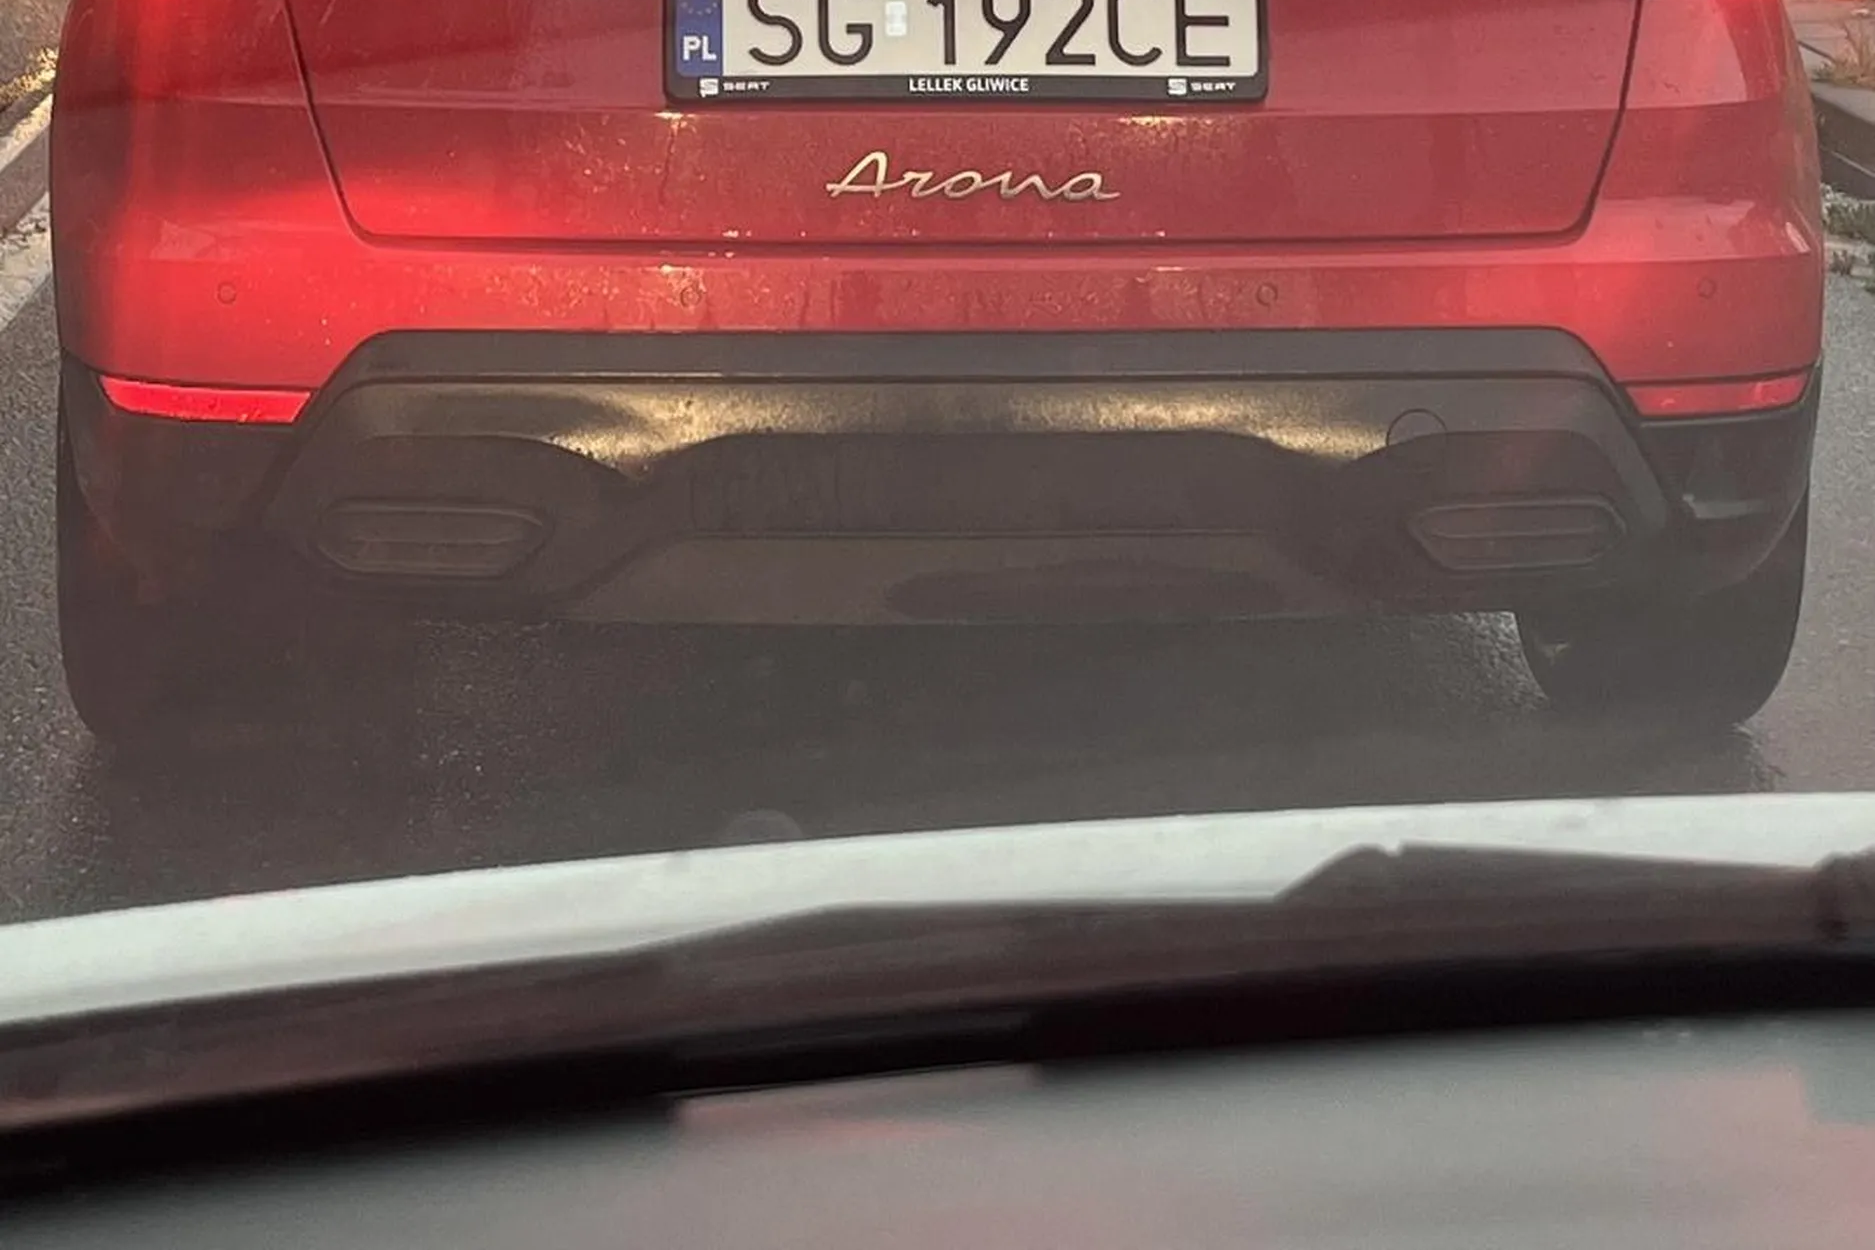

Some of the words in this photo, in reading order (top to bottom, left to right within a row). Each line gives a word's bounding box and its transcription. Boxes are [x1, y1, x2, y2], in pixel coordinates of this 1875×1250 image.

[682, 35, 717, 61] PL
[723, 80, 770, 92] SEAT
[909, 78, 962, 92] LELLEK
[966, 77, 1029, 93] GLIWICE
[1190, 81, 1236, 92] SEAT
[826, 151, 1121, 200] Arona
